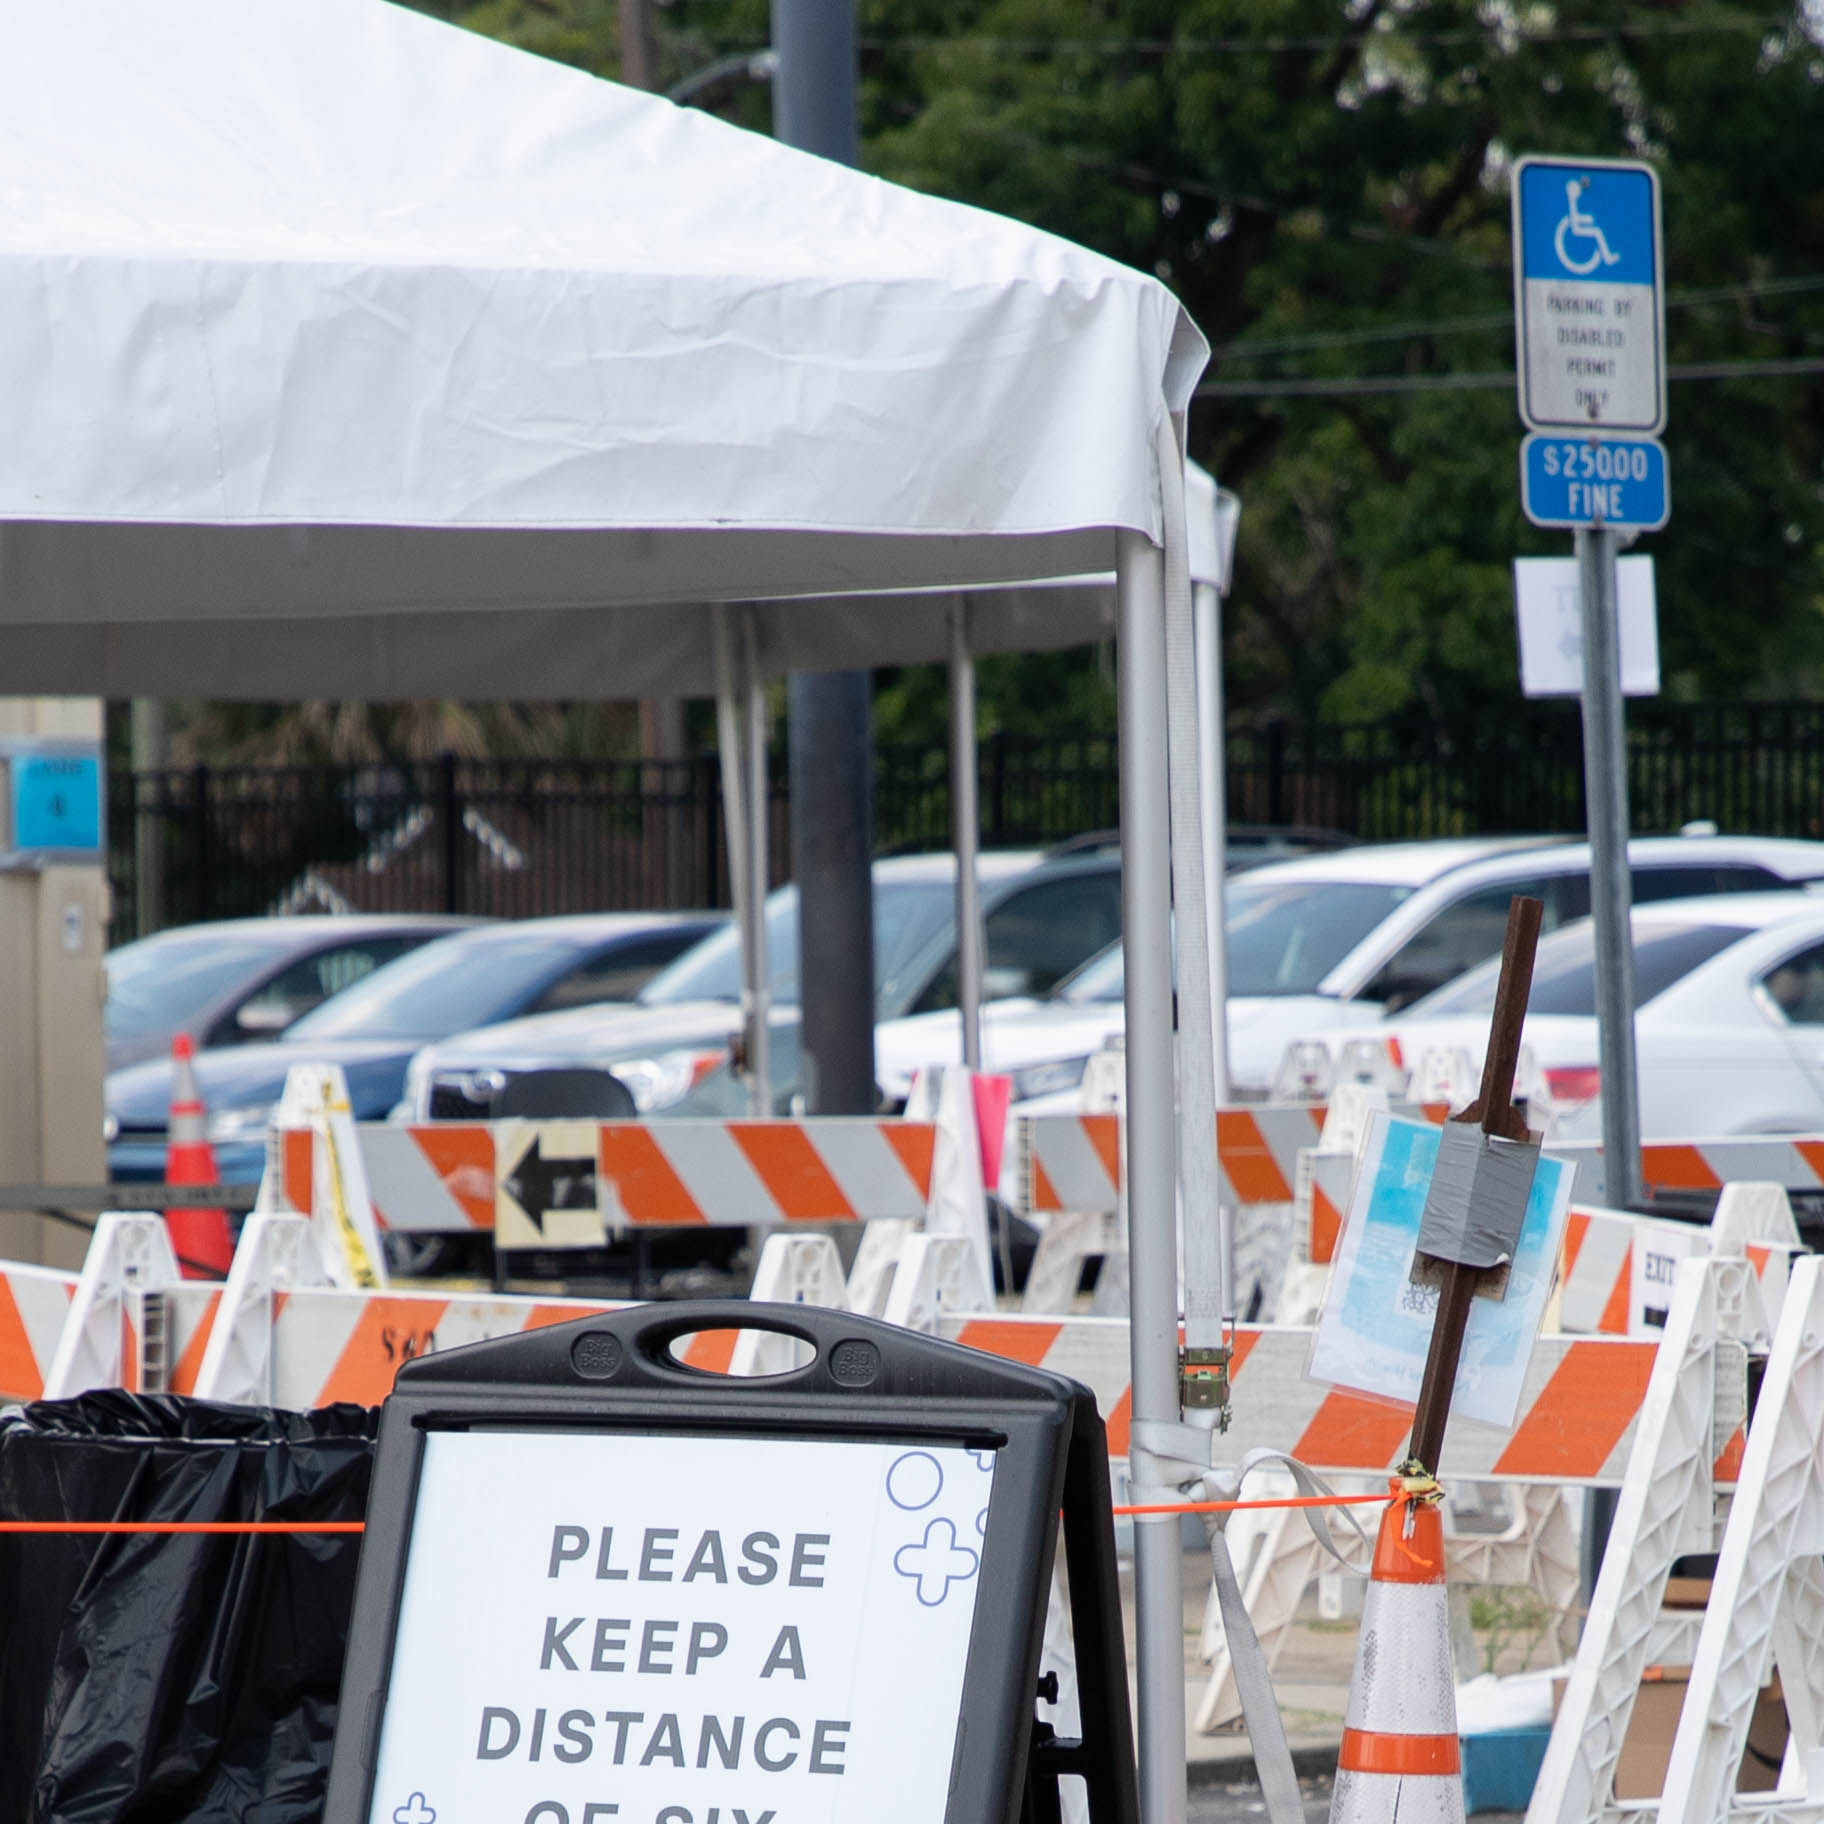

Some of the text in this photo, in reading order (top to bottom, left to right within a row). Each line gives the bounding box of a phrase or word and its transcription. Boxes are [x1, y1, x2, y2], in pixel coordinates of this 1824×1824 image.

[1568, 482, 1624, 518] FINE
[1645, 1252, 1676, 1287] EXIT
[548, 1525, 831, 1588] PLEASE
[539, 1616, 807, 1680] KEEP A
[476, 1706, 851, 1775] DISTANCE
